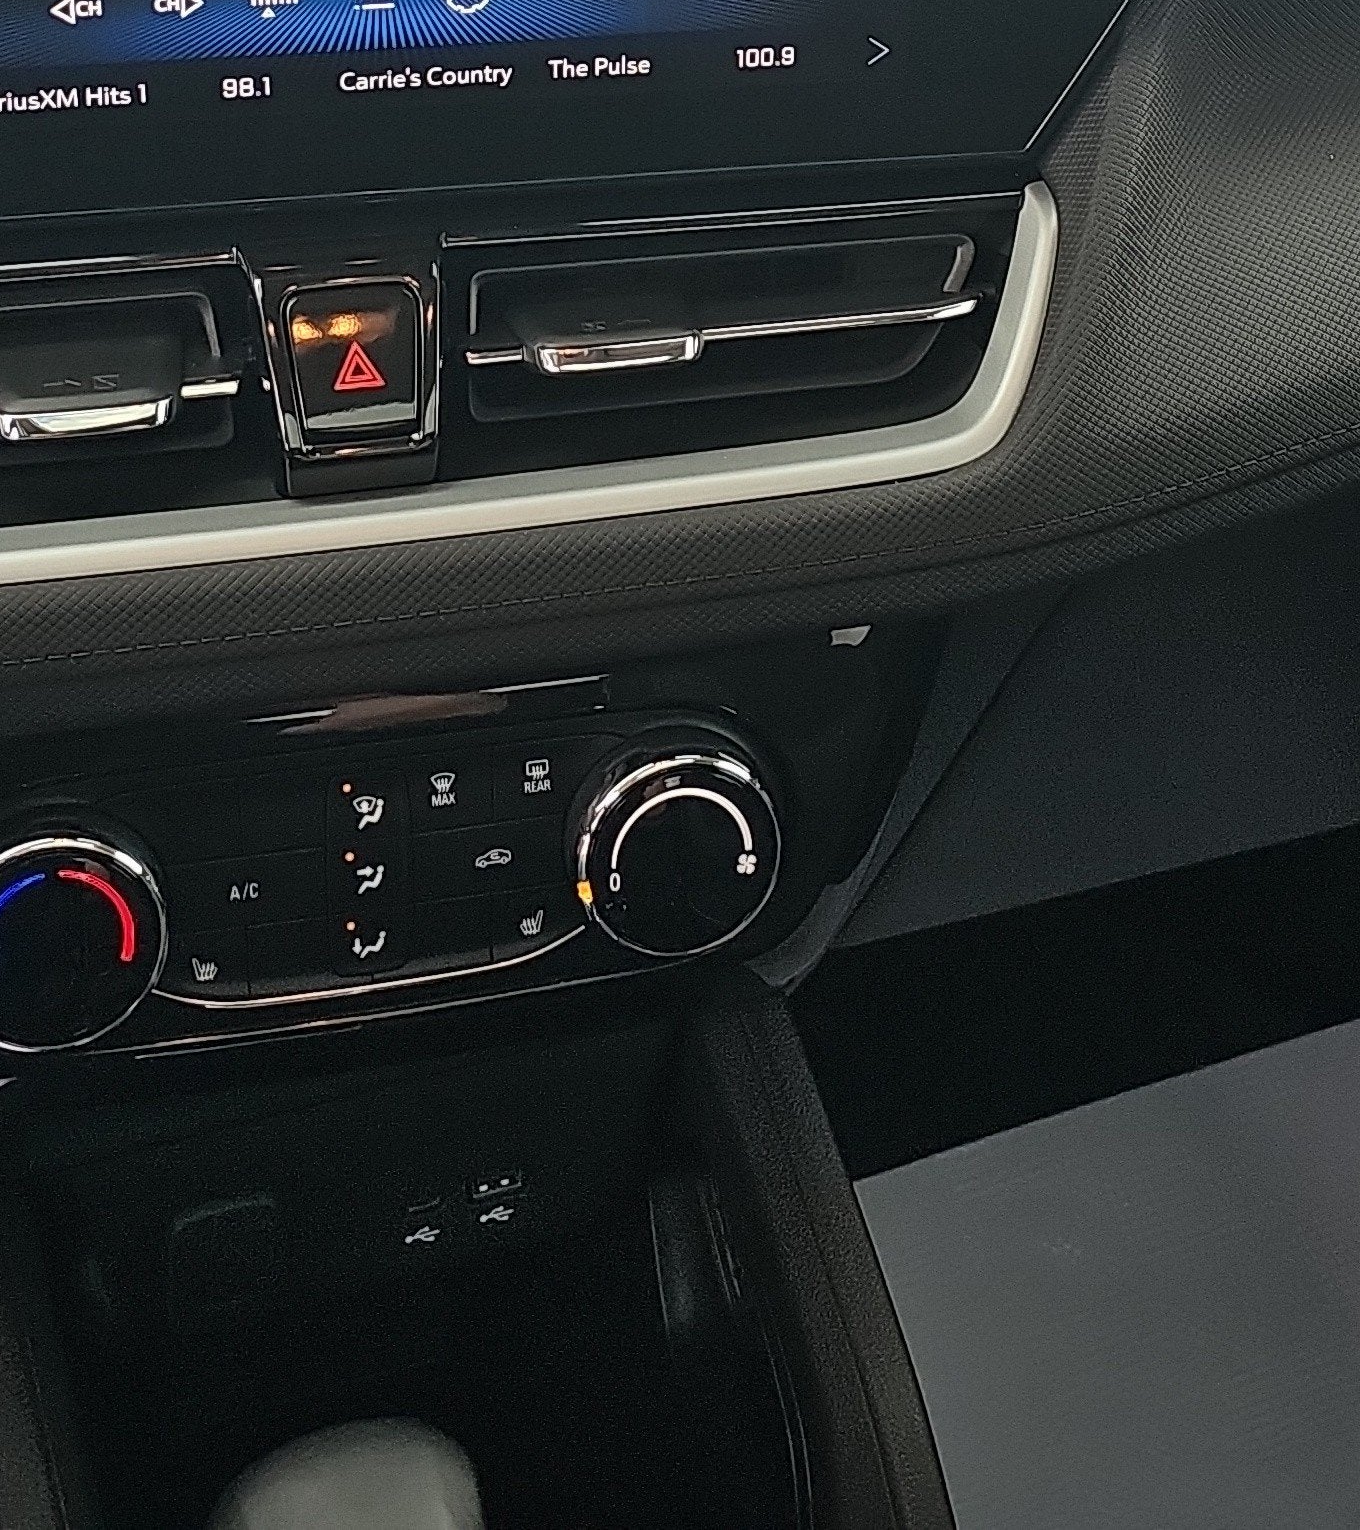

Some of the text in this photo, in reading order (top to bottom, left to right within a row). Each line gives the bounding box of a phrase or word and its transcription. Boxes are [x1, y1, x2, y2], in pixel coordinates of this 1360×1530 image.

[75, 0, 104, 18] CH
[547, 54, 651, 80] The Pulse
[735, 46, 796, 68] 100.9
[221, 76, 272, 99] 98.1
[338, 65, 513, 92] Carrie's Country
[85, 85, 133, 108] Hits
[136, 83, 148, 105] 1
[524, 779, 551, 793] REAR
[431, 792, 456, 807] MAX
[229, 881, 259, 901] A/C
